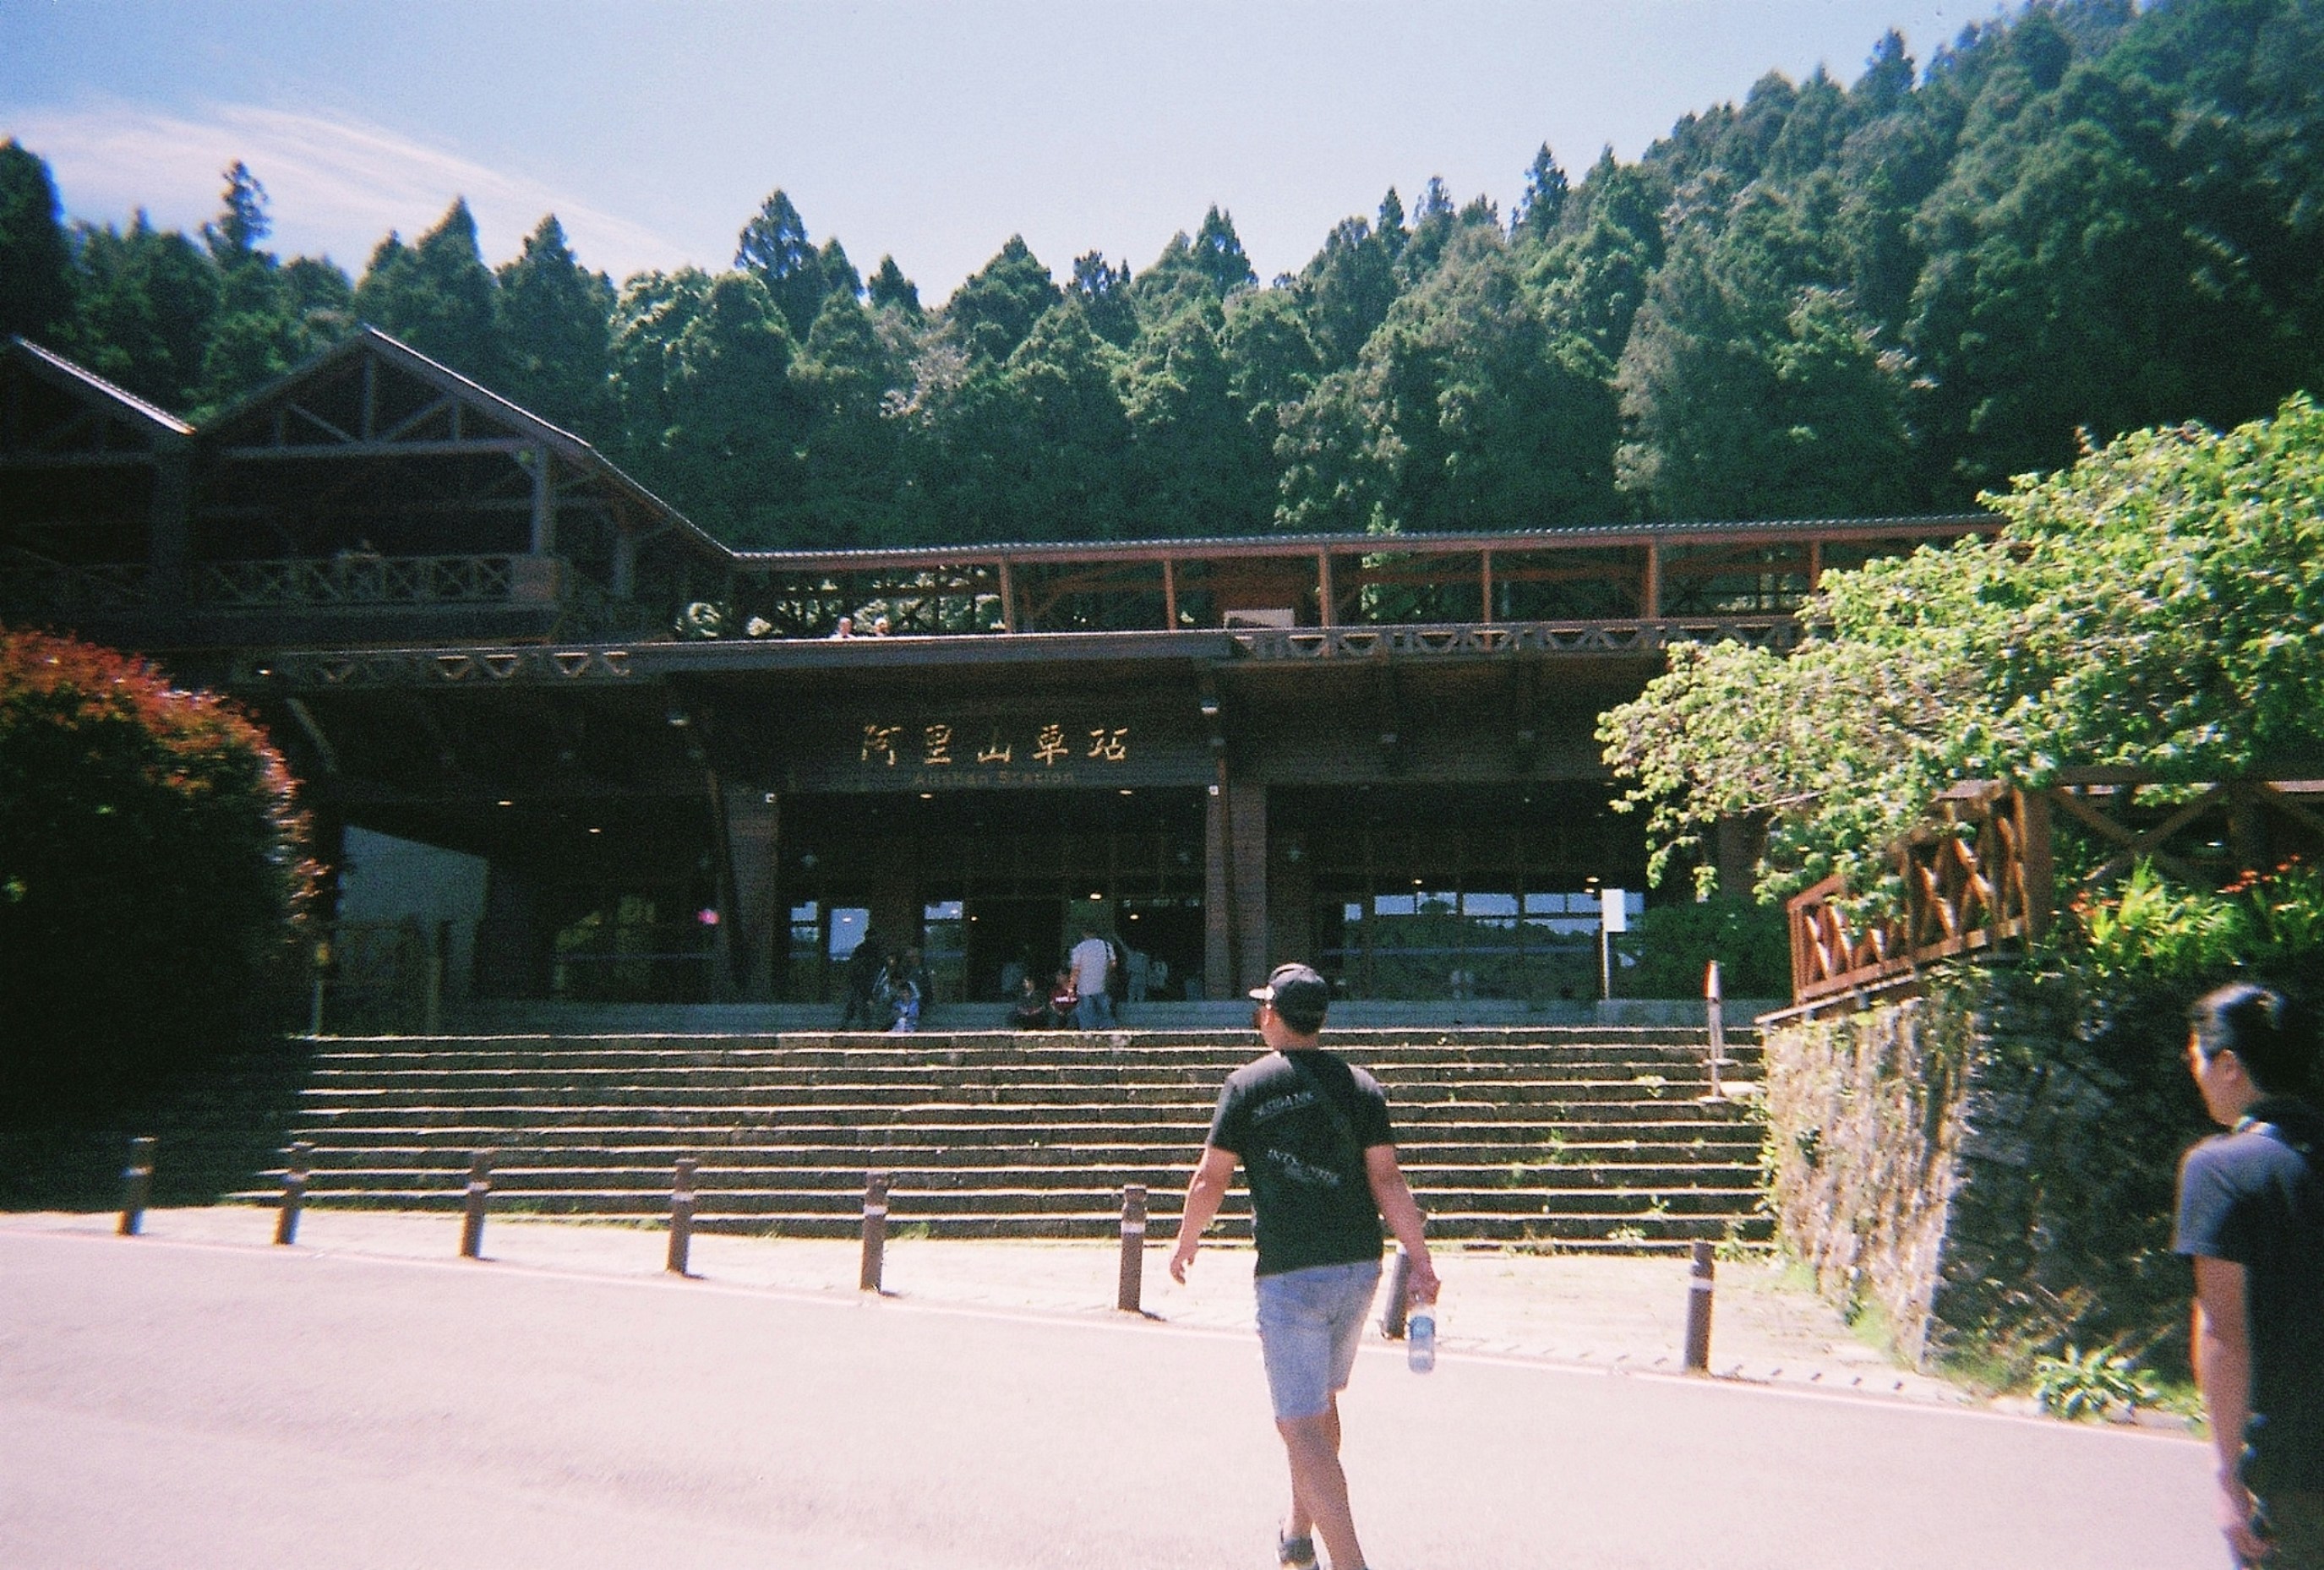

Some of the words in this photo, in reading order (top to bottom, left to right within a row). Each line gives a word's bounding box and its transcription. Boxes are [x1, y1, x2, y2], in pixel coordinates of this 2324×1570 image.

[861, 723, 1128, 766] 阿里山車站
